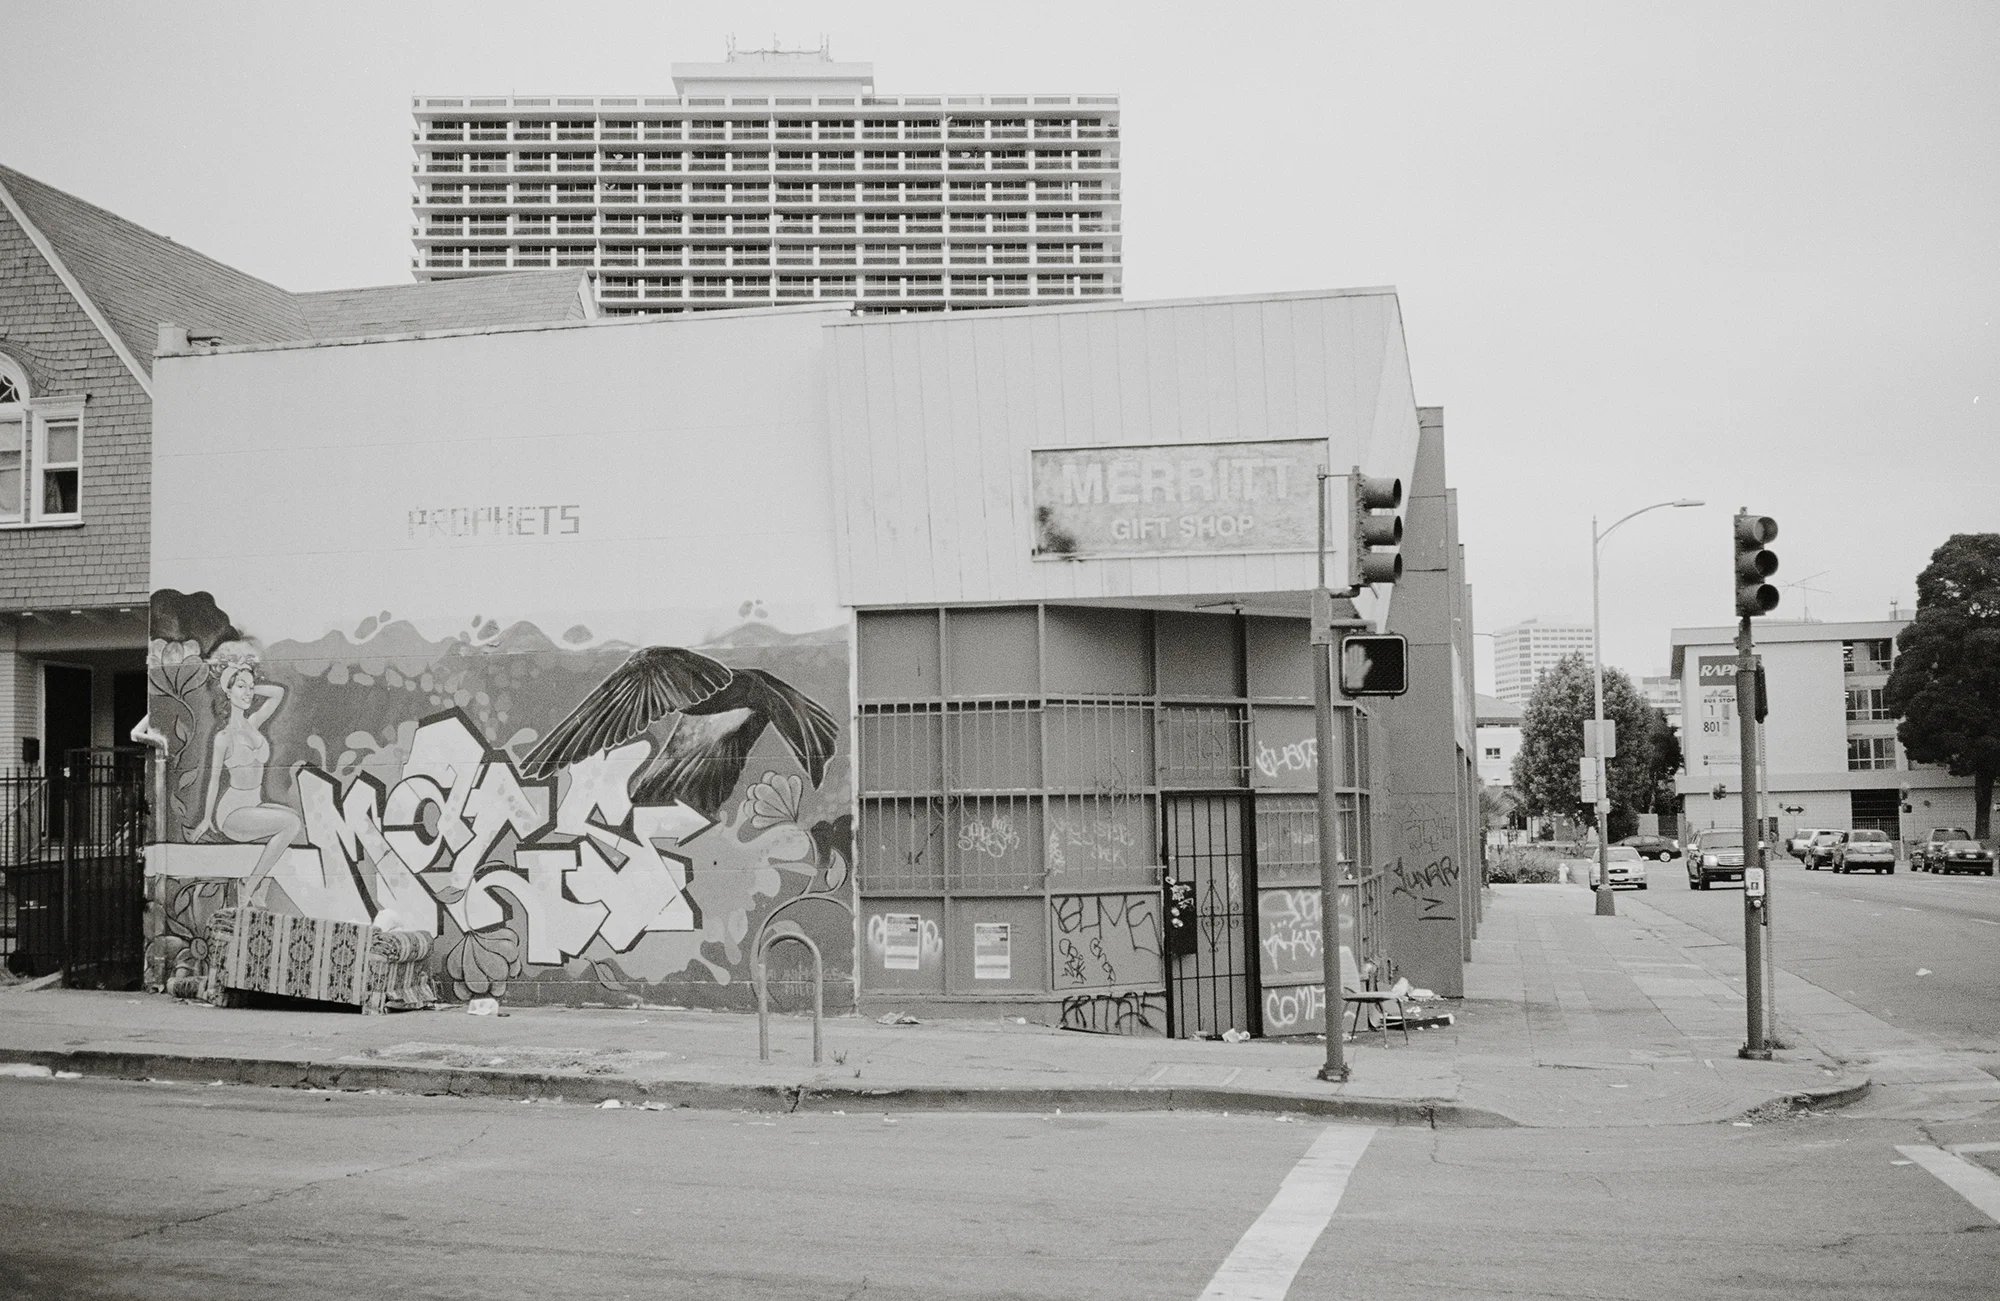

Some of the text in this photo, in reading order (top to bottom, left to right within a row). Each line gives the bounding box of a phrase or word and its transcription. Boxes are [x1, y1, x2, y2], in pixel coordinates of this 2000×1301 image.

[1061, 456, 1299, 505] MERRITT
[1110, 513, 1256, 541] GIFT SHOP
[1709, 704, 1714, 716] 1
[1703, 721, 1720, 733] 801
